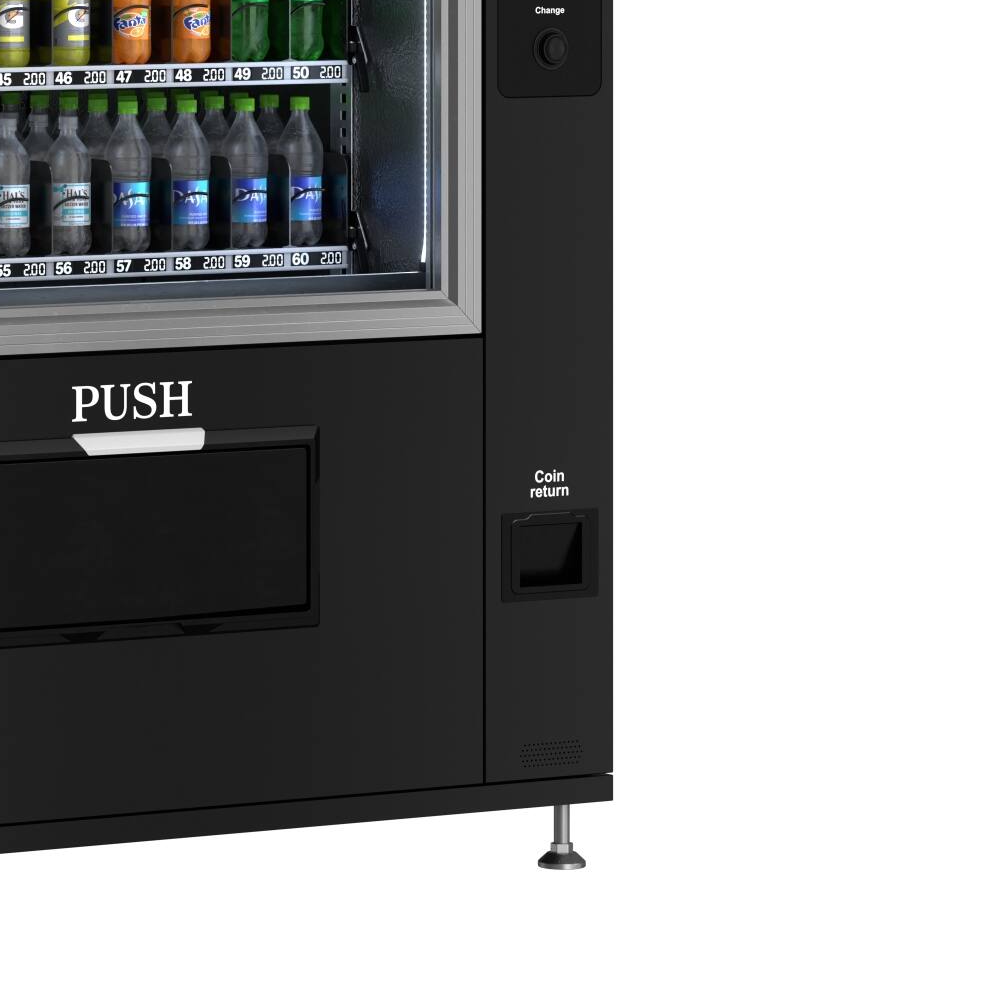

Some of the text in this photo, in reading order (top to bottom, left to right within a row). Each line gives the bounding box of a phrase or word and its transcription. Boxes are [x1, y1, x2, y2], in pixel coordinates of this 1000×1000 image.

[535, 6, 565, 15] Change
[114, 14, 147, 31] Fanta
[183, 14, 211, 31] Fant
[55, 72, 72, 85] 46
[116, 71, 132, 83] 47
[175, 69, 192, 82] 48
[234, 68, 251, 80] 49
[293, 67, 309, 79] 50
[175, 257, 191, 270] 58
[234, 255, 250, 268] 59
[292, 253, 309, 265] 60
[55, 262, 72, 275] 56
[116, 260, 131, 272] 57
[71, 380, 193, 423] PUSH
[534, 469, 565, 483] Coin
[530, 485, 570, 499] return
